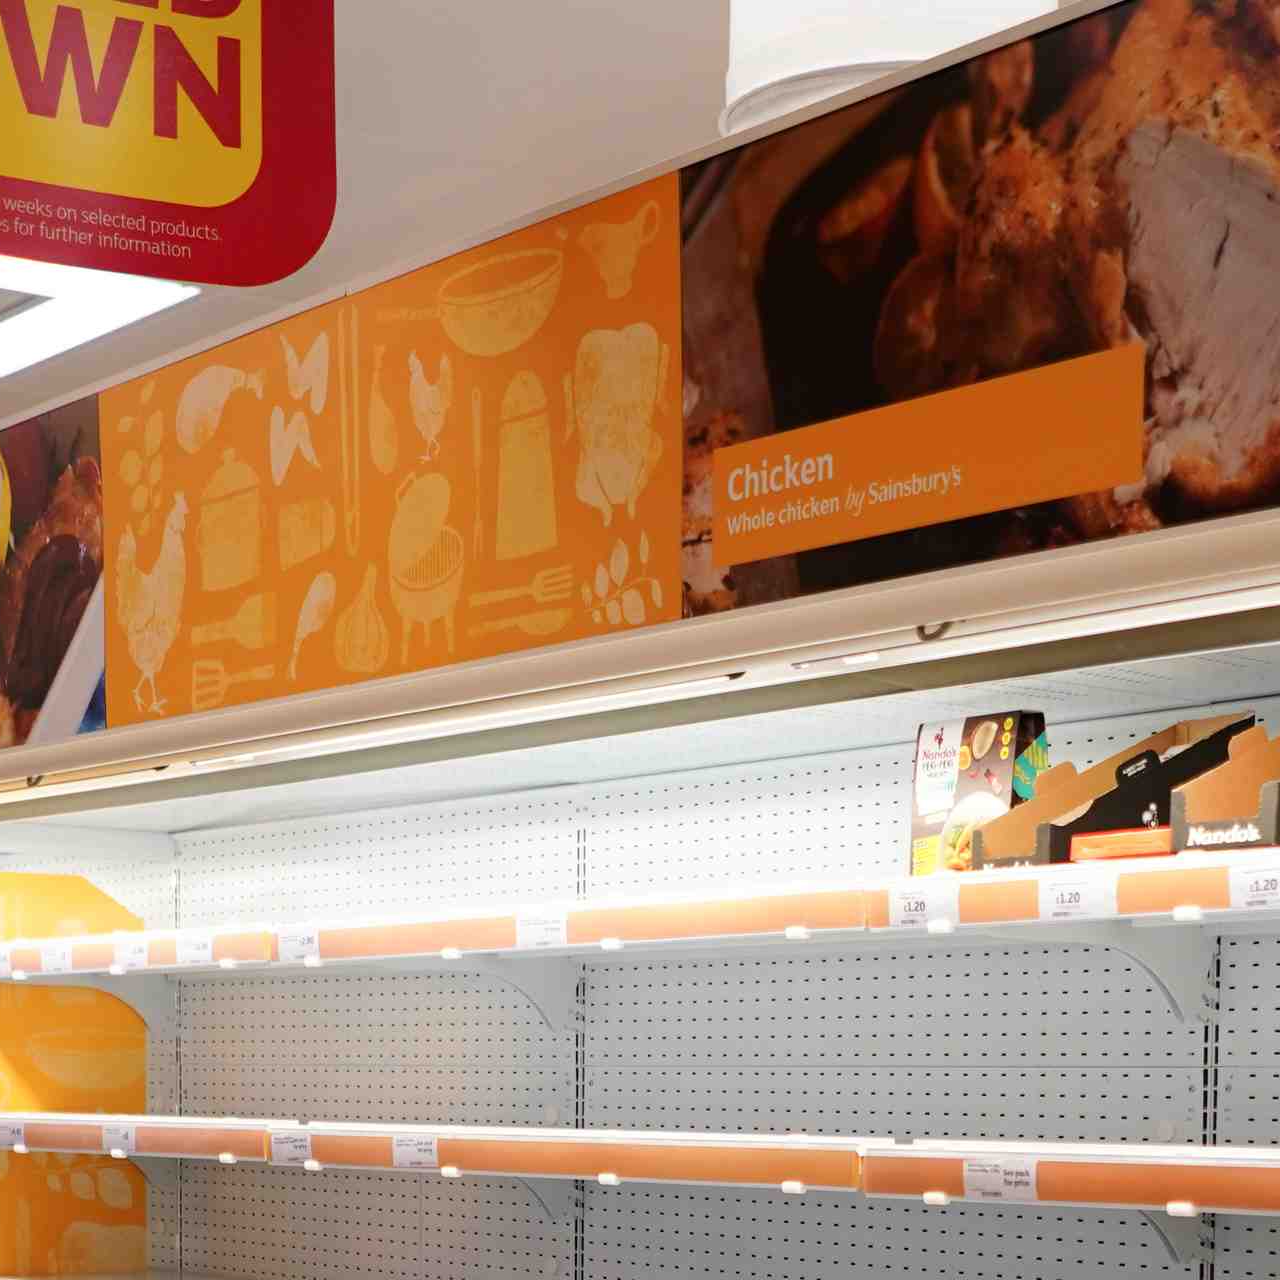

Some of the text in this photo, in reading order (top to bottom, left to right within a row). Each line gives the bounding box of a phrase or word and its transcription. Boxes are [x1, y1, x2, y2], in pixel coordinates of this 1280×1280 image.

[2, 198, 53, 217] weeks
[56, 206, 77, 221] on
[81, 208, 145, 232] selected
[13, 218, 34, 236] for
[39, 221, 93, 245] further
[98, 234, 192, 259] information
[727, 453, 833, 502] Chicken
[727, 465, 962, 536] Whole chicken by Sainsbury's
